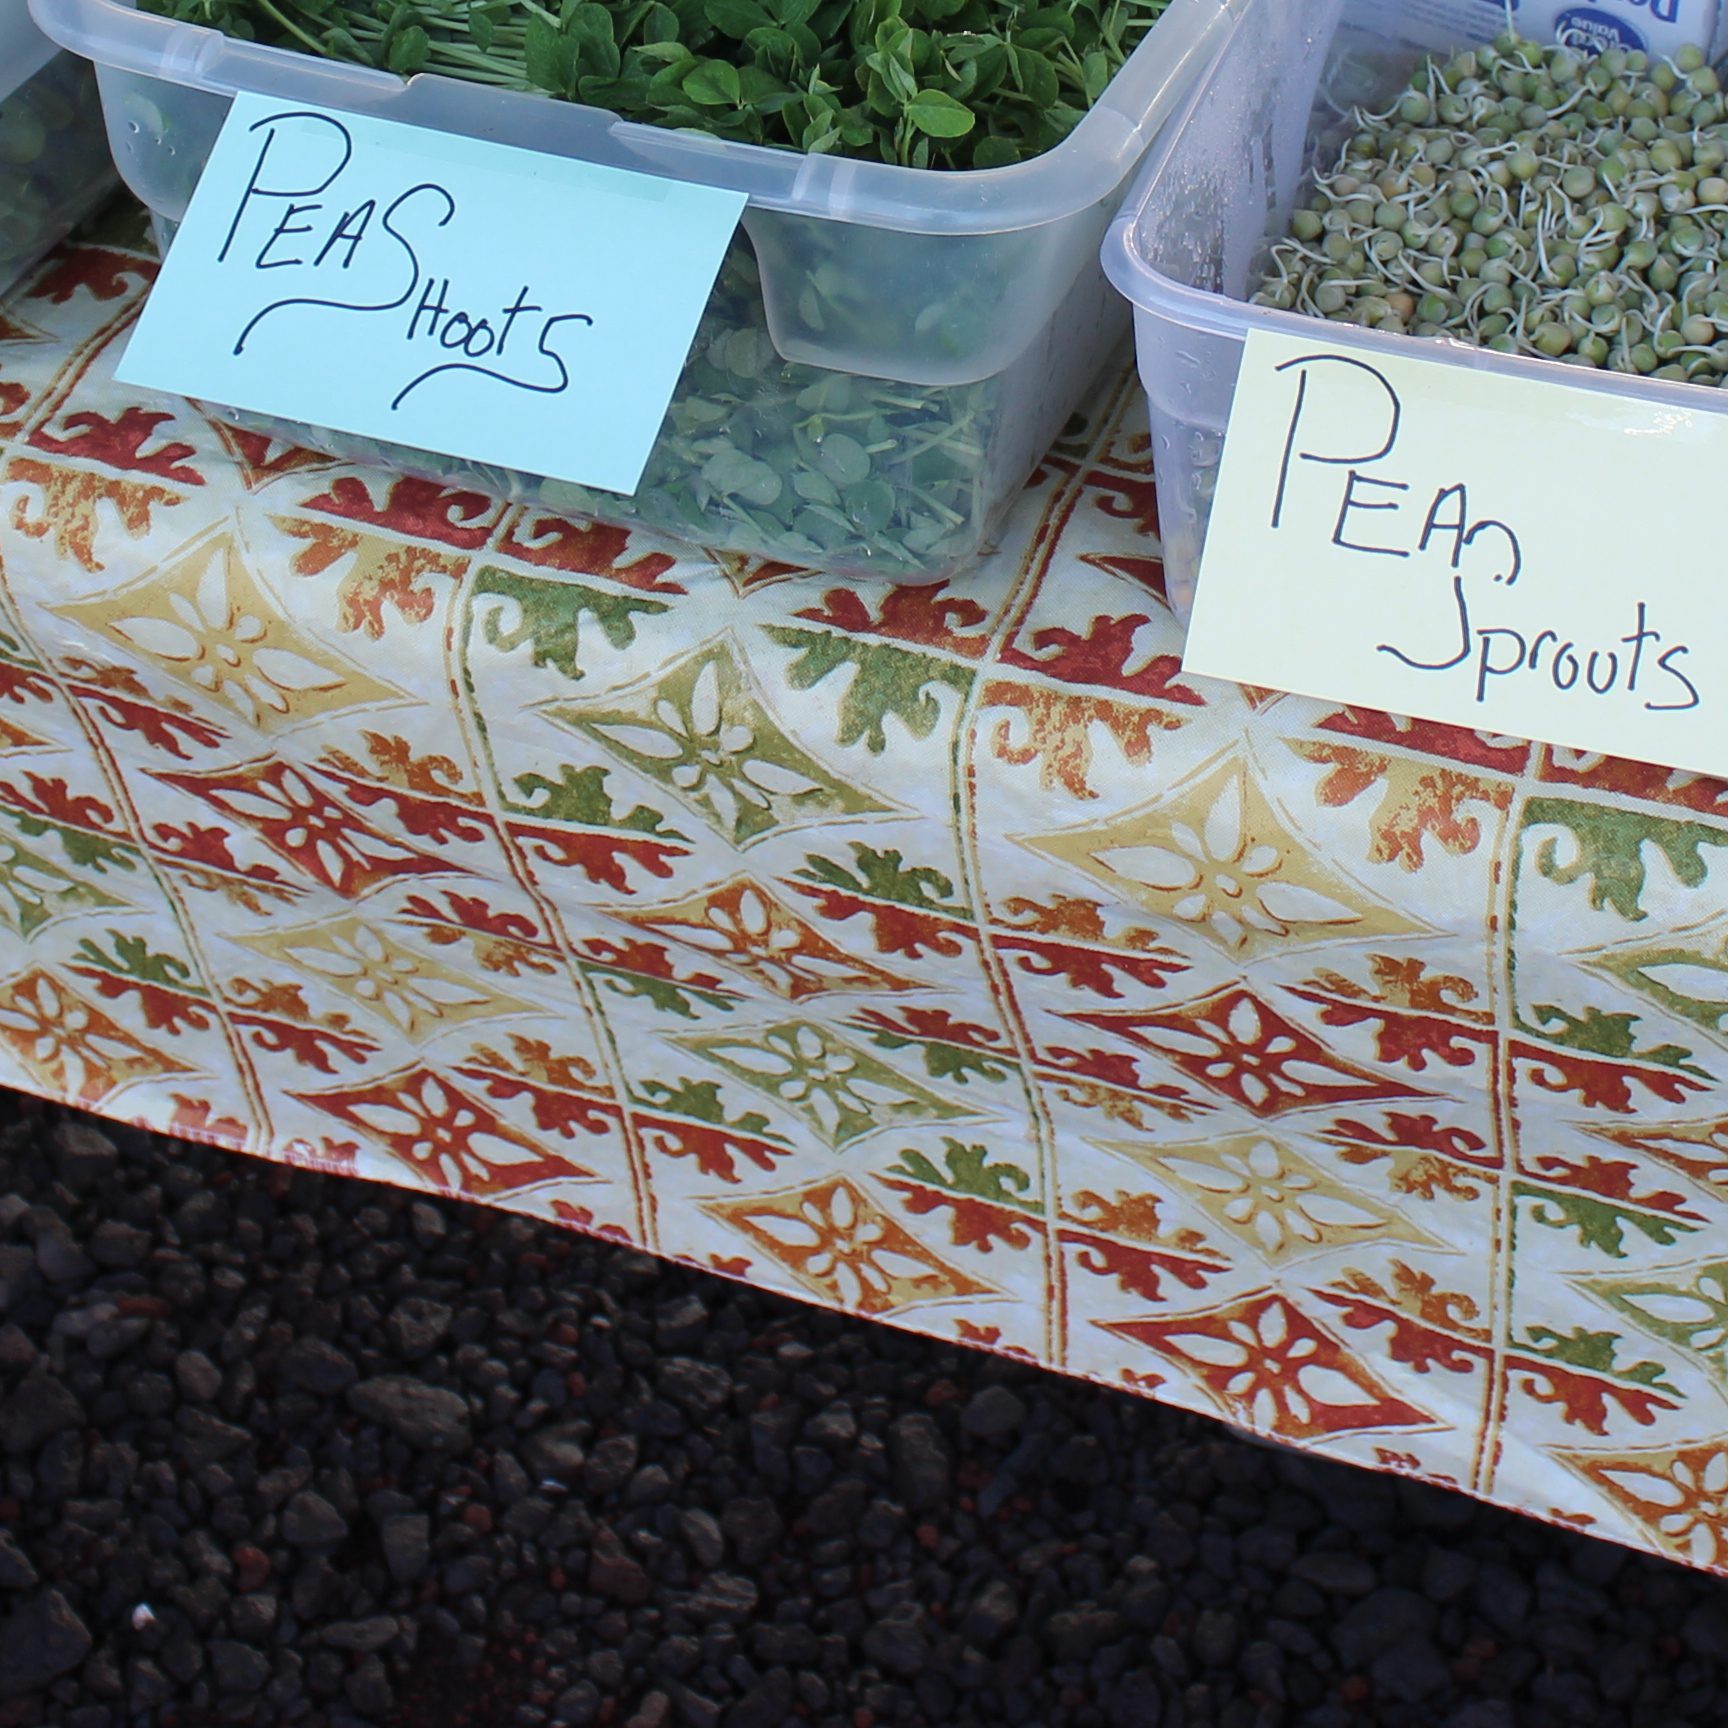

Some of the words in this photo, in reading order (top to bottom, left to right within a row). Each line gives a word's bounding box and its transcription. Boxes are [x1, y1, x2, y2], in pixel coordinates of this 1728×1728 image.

[216, 110, 377, 271] PEA
[1270, 353, 1469, 569] PEA
[1376, 520, 1701, 710] Sprouts
